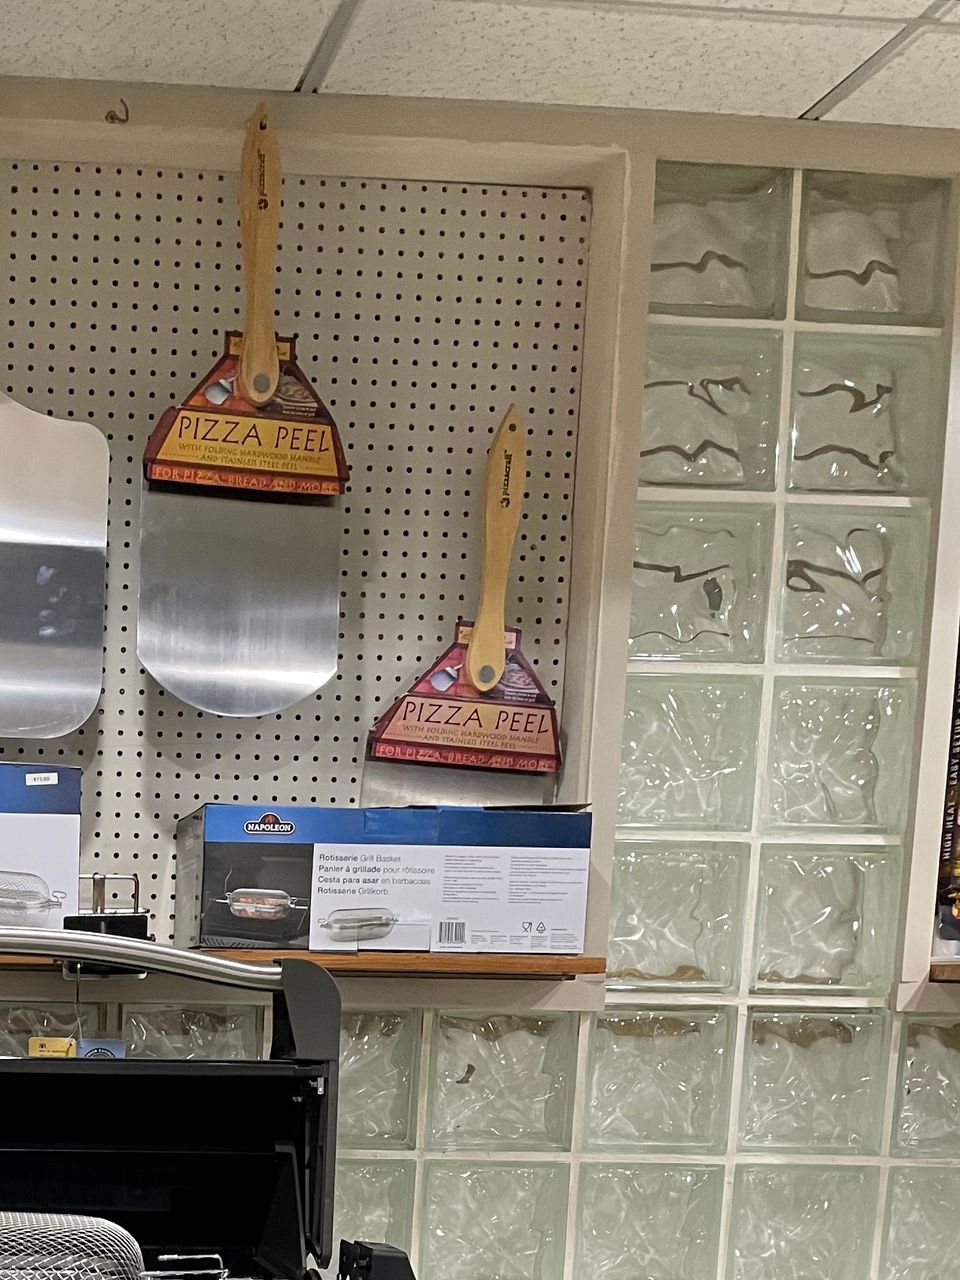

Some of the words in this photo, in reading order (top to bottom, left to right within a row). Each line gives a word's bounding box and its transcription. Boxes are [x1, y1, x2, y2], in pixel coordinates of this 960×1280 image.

[178, 416, 262, 446] PIZZA
[275, 426, 330, 452] PEEL
[179, 443, 200, 452] WITH
[205, 445, 238, 456] FOLDING
[240, 449, 288, 460] HARDWOOD
[290, 454, 320, 463] HANDLE
[201, 454, 218, 462] AND
[221, 456, 256, 466] STAINLESS
[260, 460, 279, 468] STEEL
[281, 462, 297, 470] PEEL
[156, 467, 178, 478] FOR
[229, 475, 266, 488] BREAD
[271, 479, 295, 490] AND
[402, 701, 483, 728] PIZZA
[495, 710, 549, 734] PEEL
[403, 724, 424, 732] WITH
[426, 727, 458, 737] FOLDING
[461, 731, 507, 741] HARDWOOD
[509, 735, 539, 744] HANDLE
[442, 736, 477, 745] STAINLESS
[480, 740, 498, 748] STEEL
[380, 745, 401, 757] FOR
[448, 752, 484, 764] BREAD
[487, 756, 513, 767] AND
[517, 760, 554, 769] MORE
[949, 759, 959, 785] EASY
[945, 801, 955, 828] HEAT
[248, 823, 292, 831] NAPOLEON
[943, 833, 952, 859] HIGH
[319, 854, 358, 862] Rotisserie
[360, 854, 375, 862] Grill
[376, 855, 401, 863] Basket
[318, 875, 340, 883] Cesta
[342, 877, 360, 885] para
[353, 866, 381, 874] grillade
[317, 887, 356, 895] Rotisserie
